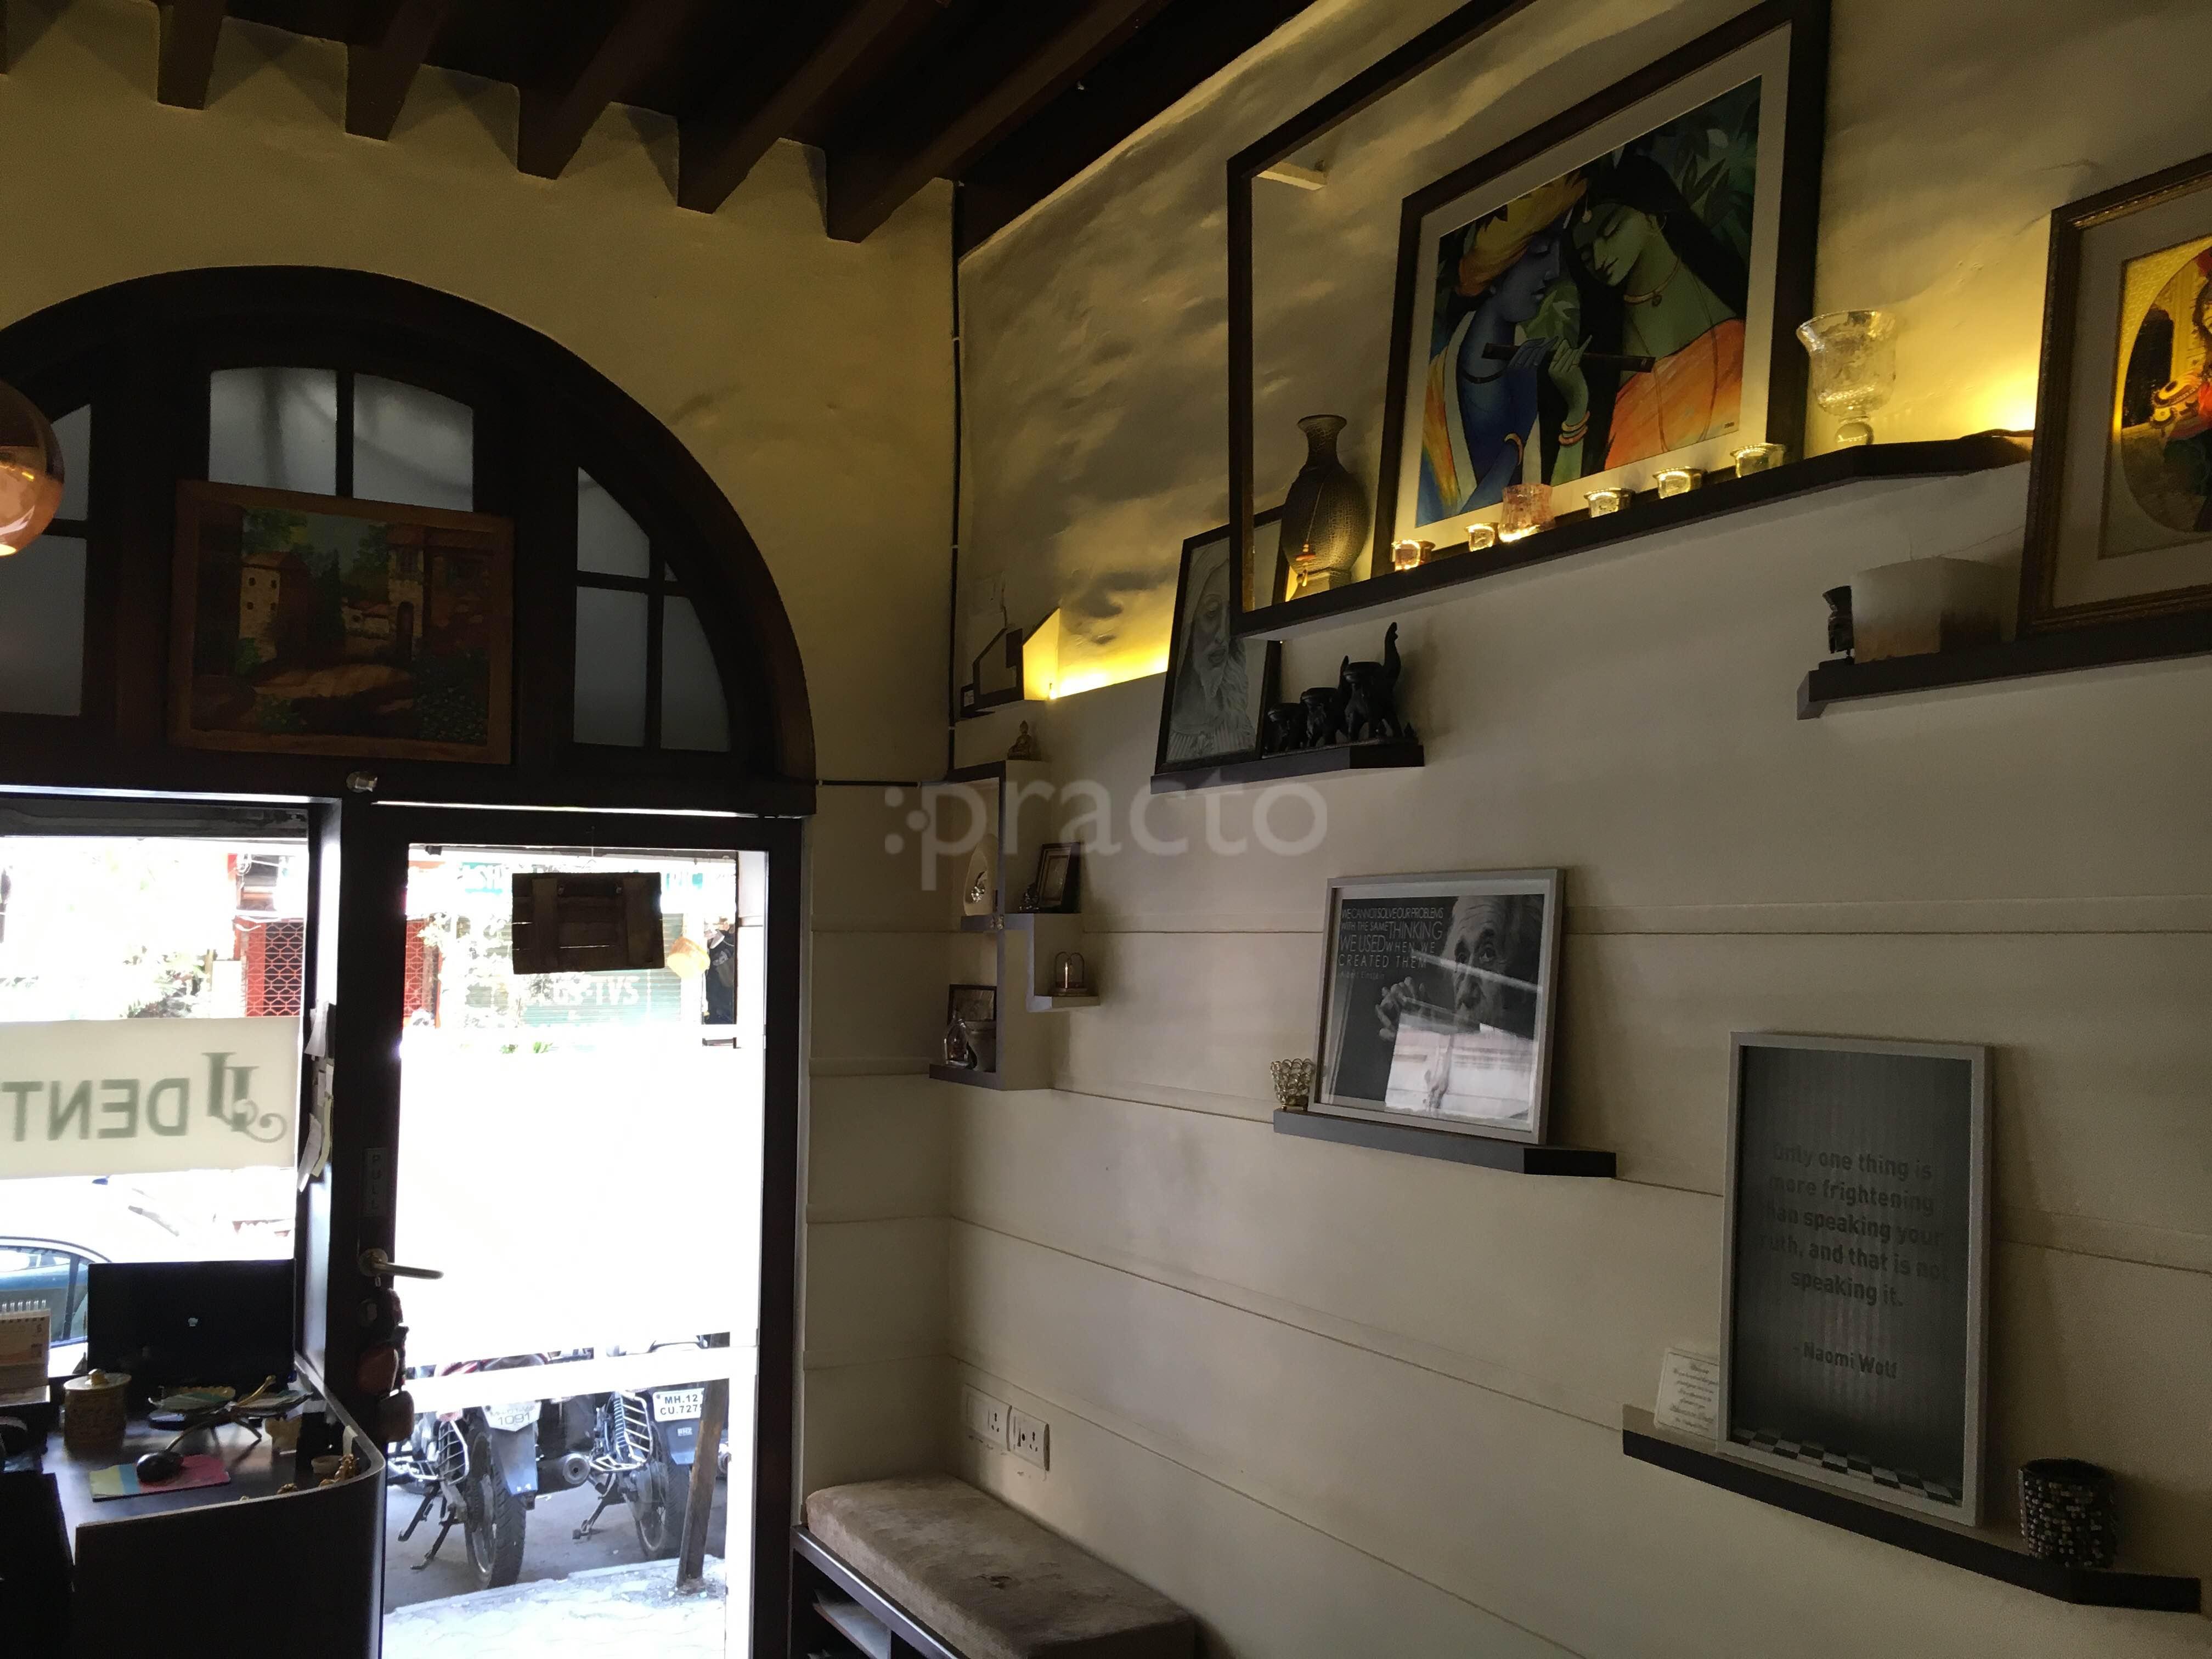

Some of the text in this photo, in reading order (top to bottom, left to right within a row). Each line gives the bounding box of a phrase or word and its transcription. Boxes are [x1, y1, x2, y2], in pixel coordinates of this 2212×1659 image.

[1340, 934, 1357, 952] WE
[1358, 934, 1386, 952] USED
[1421, 941, 1435, 953] WE
[1357, 921, 1369, 931] THE
[1370, 921, 1389, 931] SAME
[1388, 921, 1443, 940] THINKING
[1338, 953, 1427, 969] CREATED THEM
[1819, 1151, 1853, 1171] one
[1858, 1153, 1909, 1182] thing
[1914, 1159, 1932, 1180] is
[1770, 1176, 1934, 1217] more frightening
[1762, 1198, 1944, 1247] han speaking your
[1809, 1242, 1844, 1265] and
[1848, 1247, 1888, 1272] that
[1894, 1253, 1911, 1274] is
[1790, 1270, 1878, 1306] speaking
[1803, 1341, 1854, 1369] Naomi
[664, 1394, 698, 1404] MH.12
[498, 1412, 530, 1425] 1091
